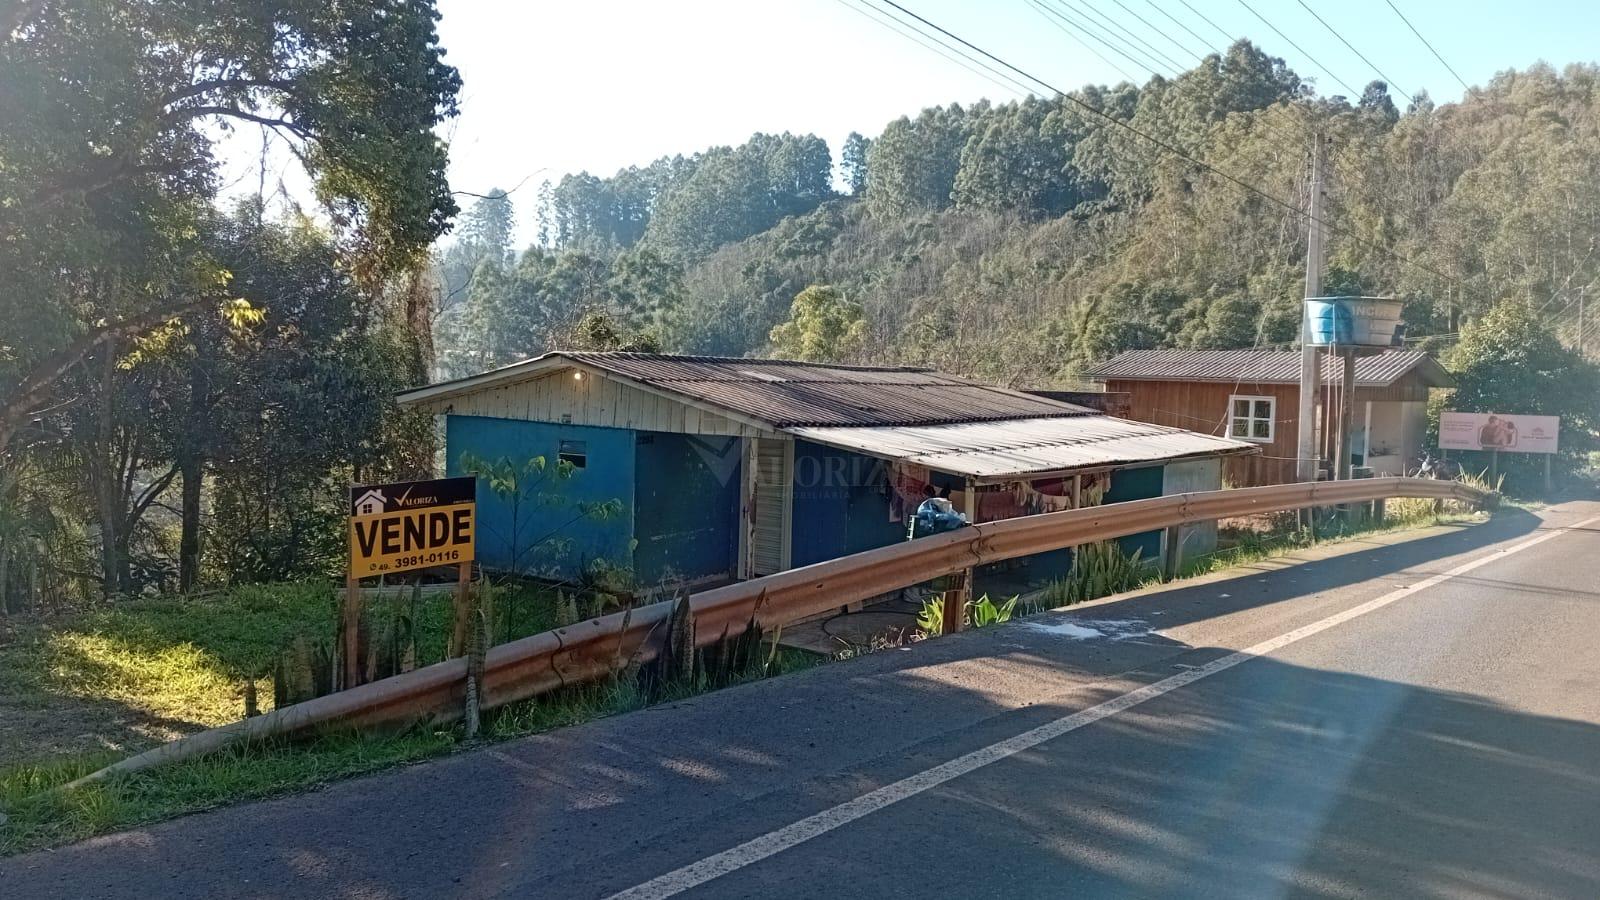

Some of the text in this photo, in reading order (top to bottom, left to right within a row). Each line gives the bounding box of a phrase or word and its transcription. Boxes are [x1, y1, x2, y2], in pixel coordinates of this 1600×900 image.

[394, 485, 438, 507] VALORIZA
[355, 509, 471, 558] VENDE
[395, 550, 459, 569] 3981-0116
